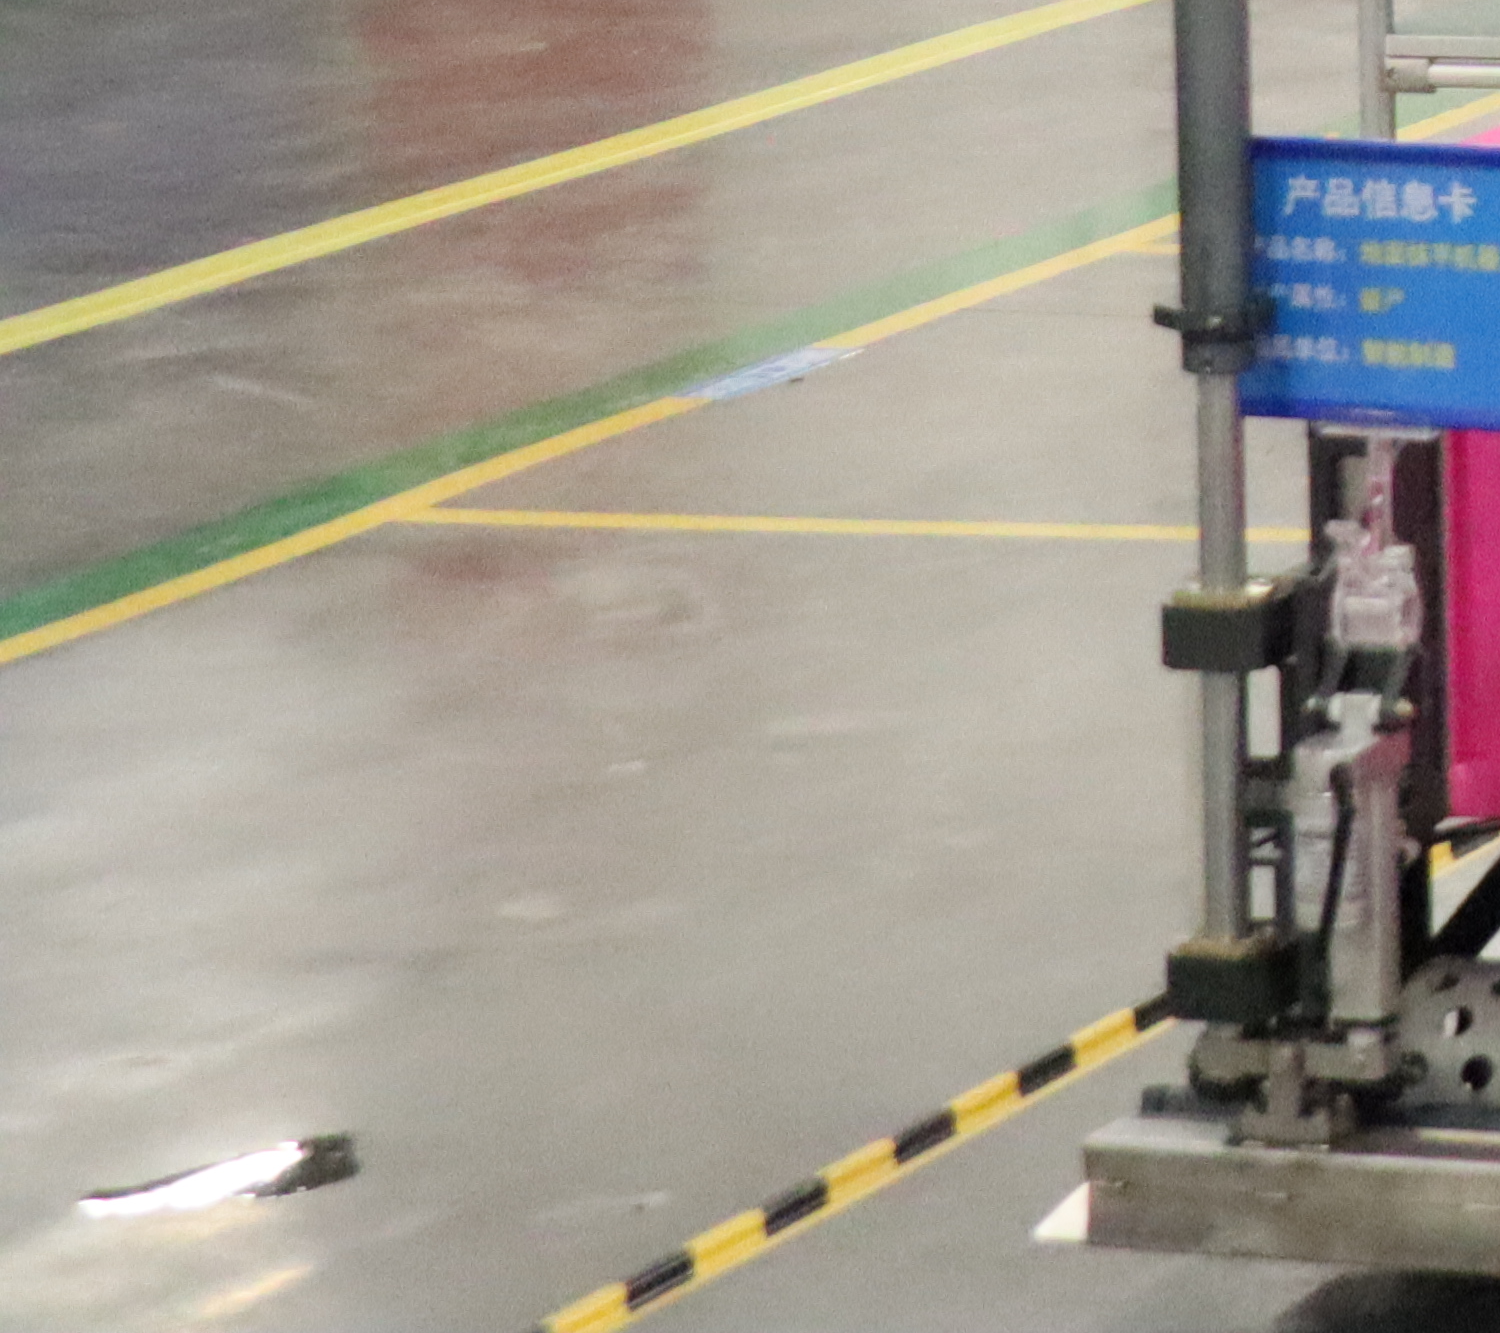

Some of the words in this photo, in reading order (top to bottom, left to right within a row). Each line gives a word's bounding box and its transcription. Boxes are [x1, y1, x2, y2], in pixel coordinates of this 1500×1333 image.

[1284, 175, 1477, 225] 产品信息卡
